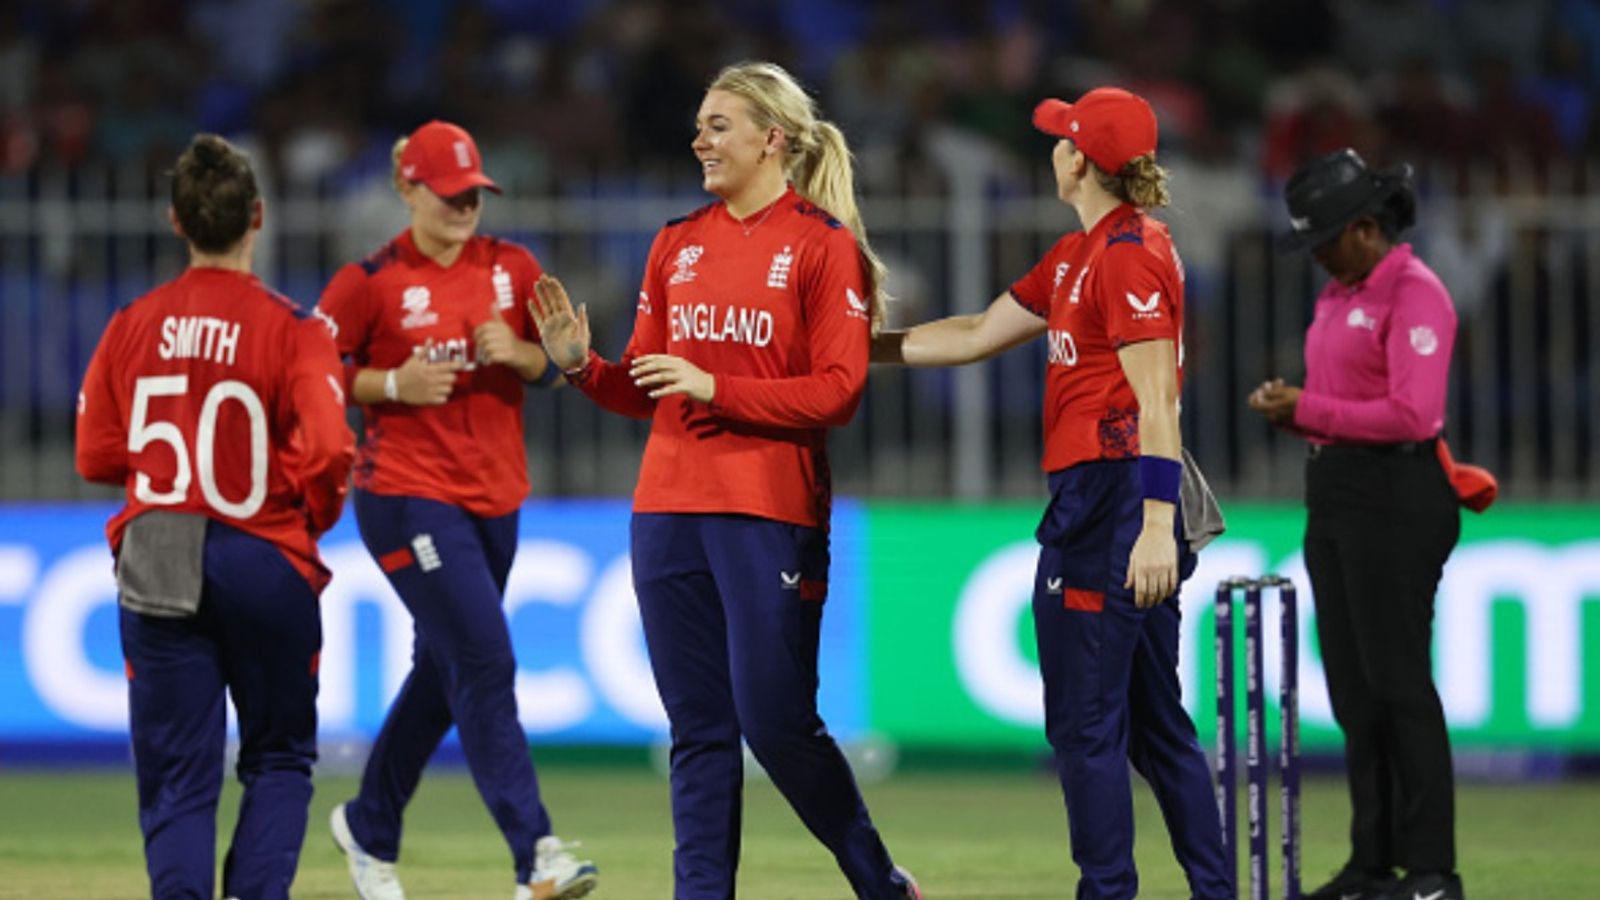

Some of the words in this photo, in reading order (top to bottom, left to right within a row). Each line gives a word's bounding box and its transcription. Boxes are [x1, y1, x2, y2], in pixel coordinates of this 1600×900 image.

[158, 316, 240, 366] SMITH
[671, 303, 773, 347] ENGLAND
[127, 374, 268, 520] 50
